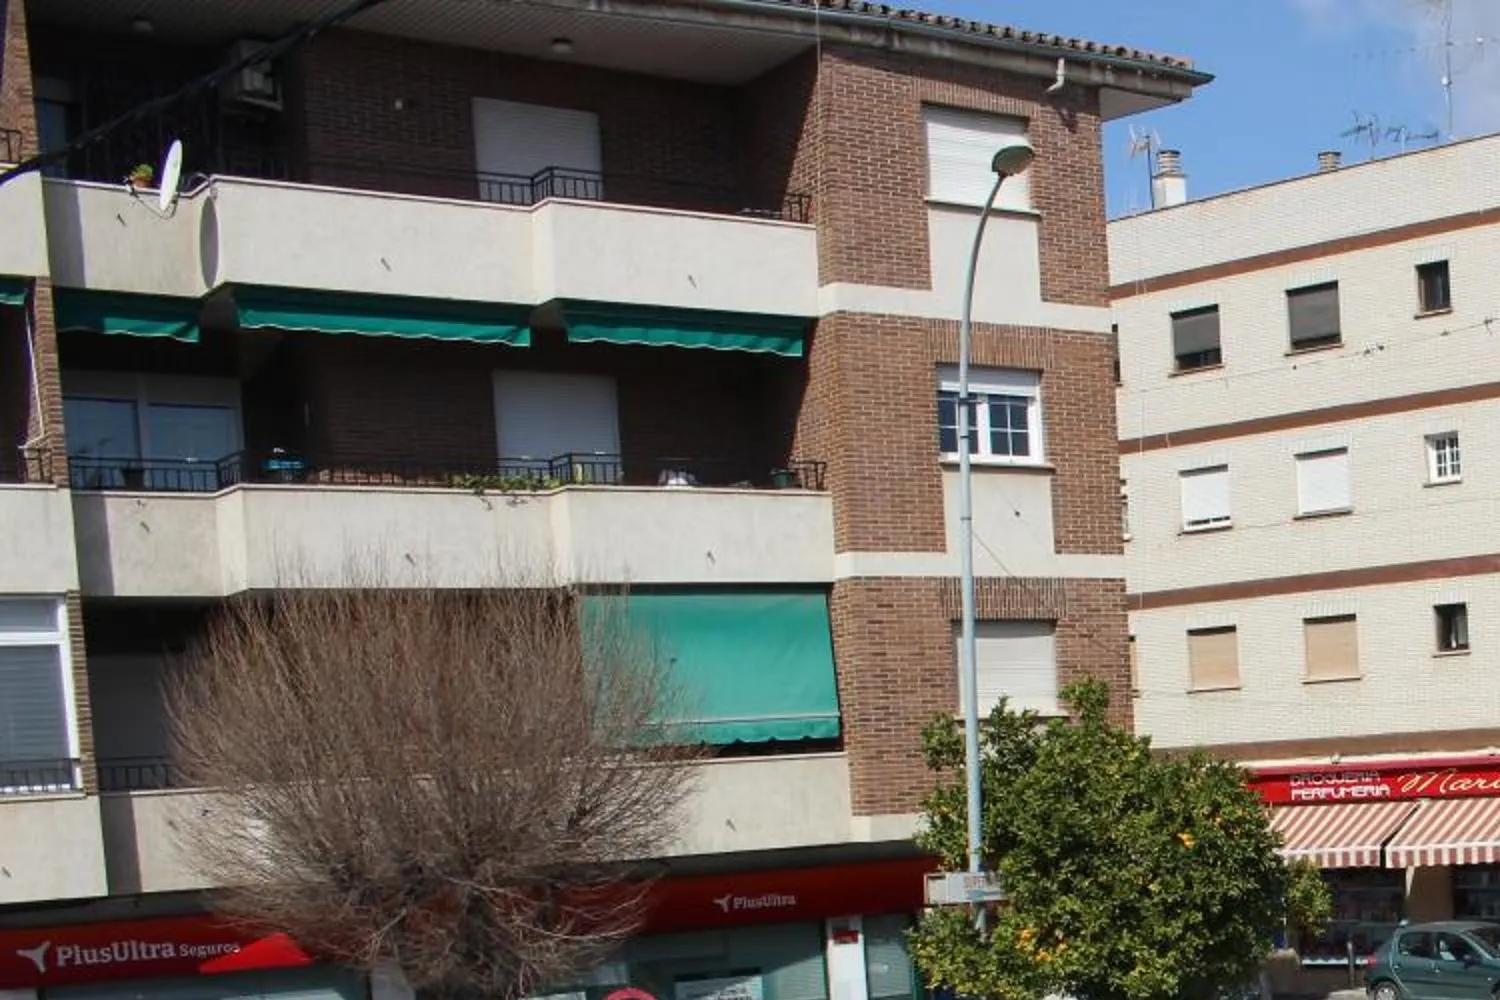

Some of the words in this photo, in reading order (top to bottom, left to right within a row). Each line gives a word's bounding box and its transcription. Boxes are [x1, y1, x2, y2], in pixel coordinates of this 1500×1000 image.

[1289, 771, 1381, 786] DROGUERIA
[1290, 786, 1391, 801] PERFUMERIA
[733, 894, 798, 909] PlusUltra
[56, 940, 177, 967] PlusUltra
[179, 941, 241, 958] Seguros
